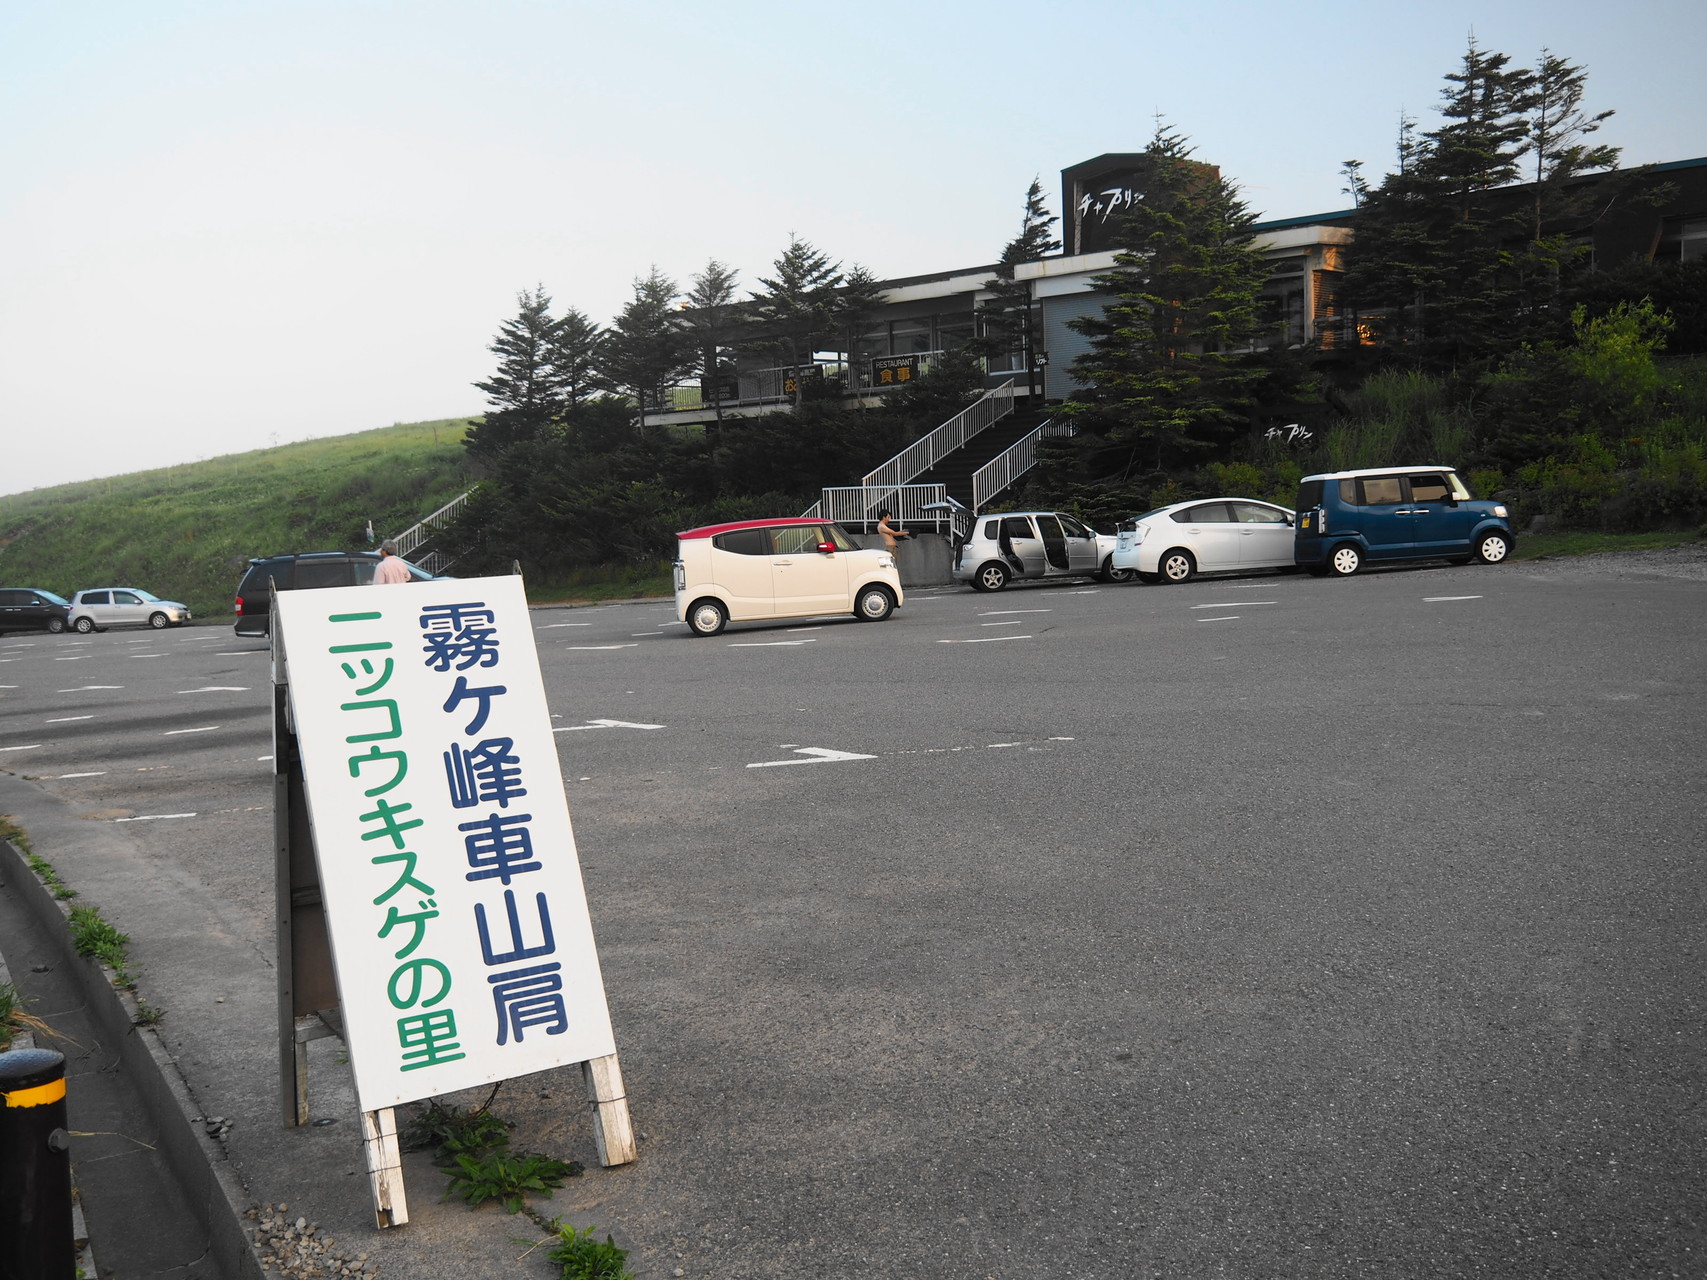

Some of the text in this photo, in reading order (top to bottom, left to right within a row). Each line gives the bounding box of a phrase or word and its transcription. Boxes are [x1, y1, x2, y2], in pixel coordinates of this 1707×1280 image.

[875, 357, 914, 369] RESTAURANT
[879, 367, 911, 384] 食事
[1263, 423, 1313, 444] チャプリン
[418, 601, 569, 1046] 霧ケ峰車山肩
[328, 610, 466, 1072] ニッコウキスゲの里
